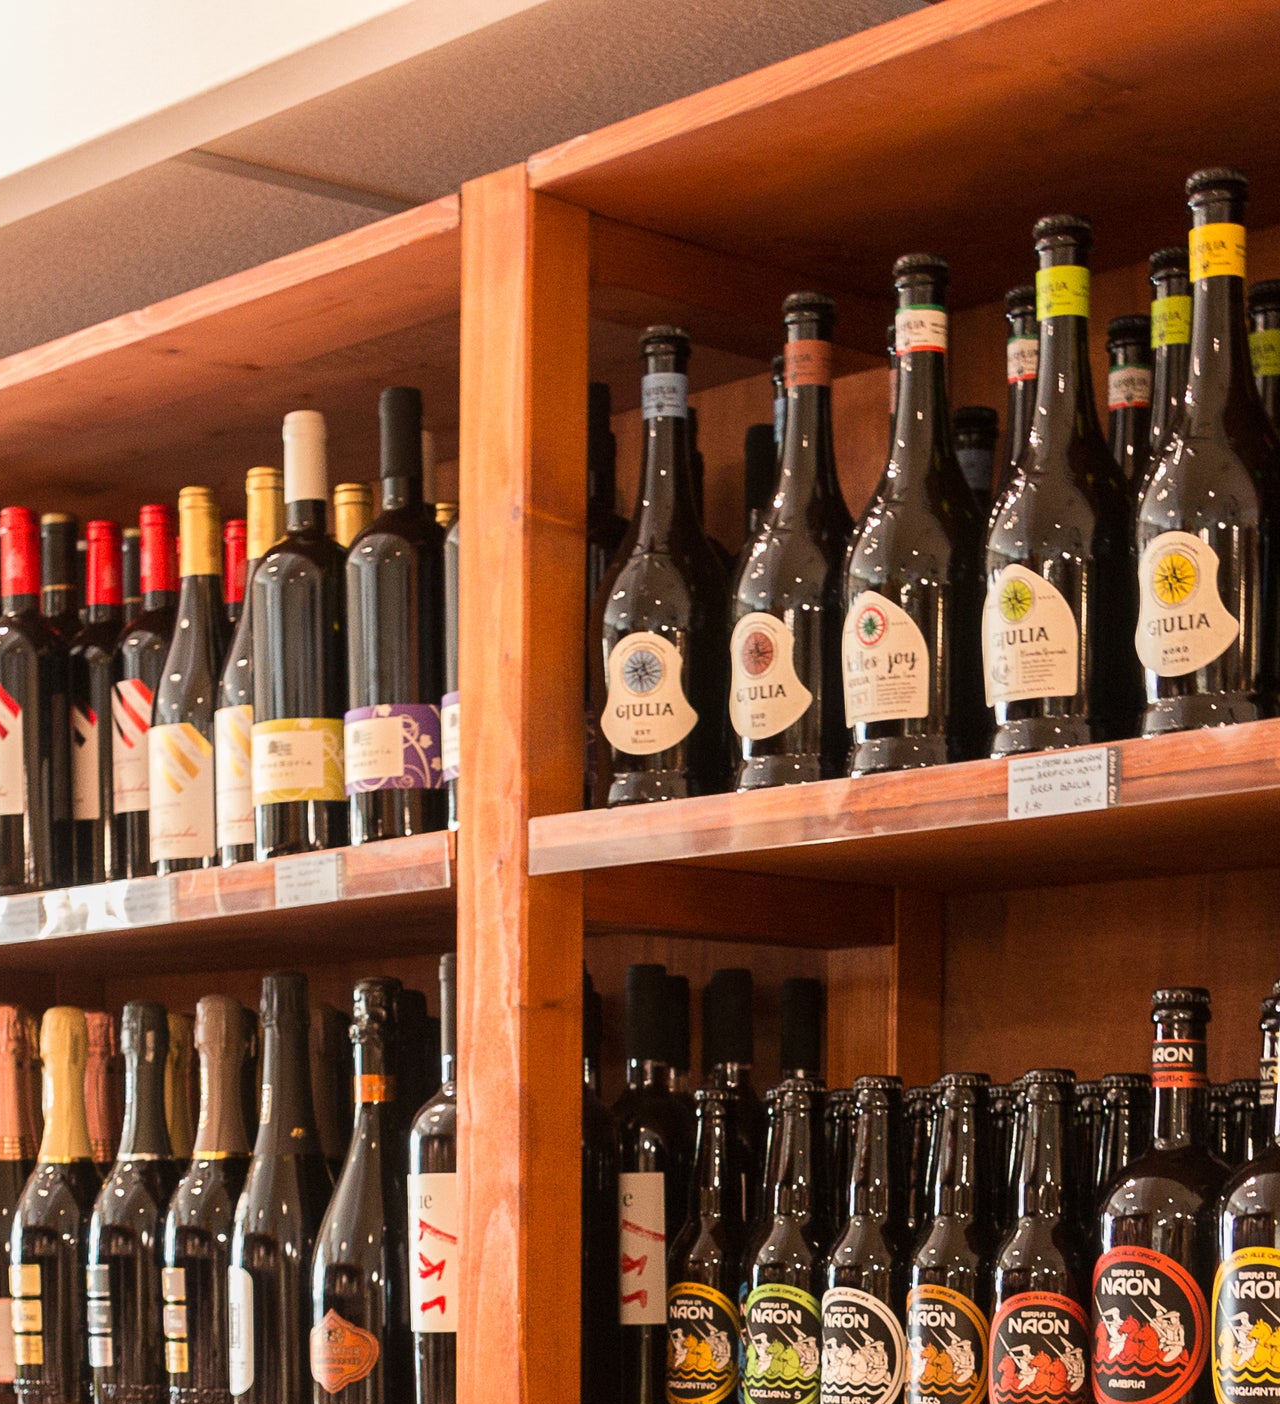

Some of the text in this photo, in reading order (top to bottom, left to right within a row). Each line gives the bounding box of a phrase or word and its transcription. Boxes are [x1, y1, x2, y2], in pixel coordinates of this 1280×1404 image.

[1147, 613, 1210, 635] GJULIA
[888, 652, 915, 673] joy
[616, 703, 674, 721] GJULIA
[1111, 1269, 1133, 1277] BIRRA
[1239, 1272, 1276, 1280] BIRRA DI
[1102, 1278, 1160, 1296] NAON
[670, 1306, 713, 1320] NAON
[752, 1309, 801, 1324] NAON
[825, 1313, 868, 1328] NAON
[909, 1311, 955, 1327] NAON
[1008, 1319, 1069, 1334] NAON
[1109, 1379, 1145, 1388] AMBRIA
[841, 1396, 871, 1404] BLANC
